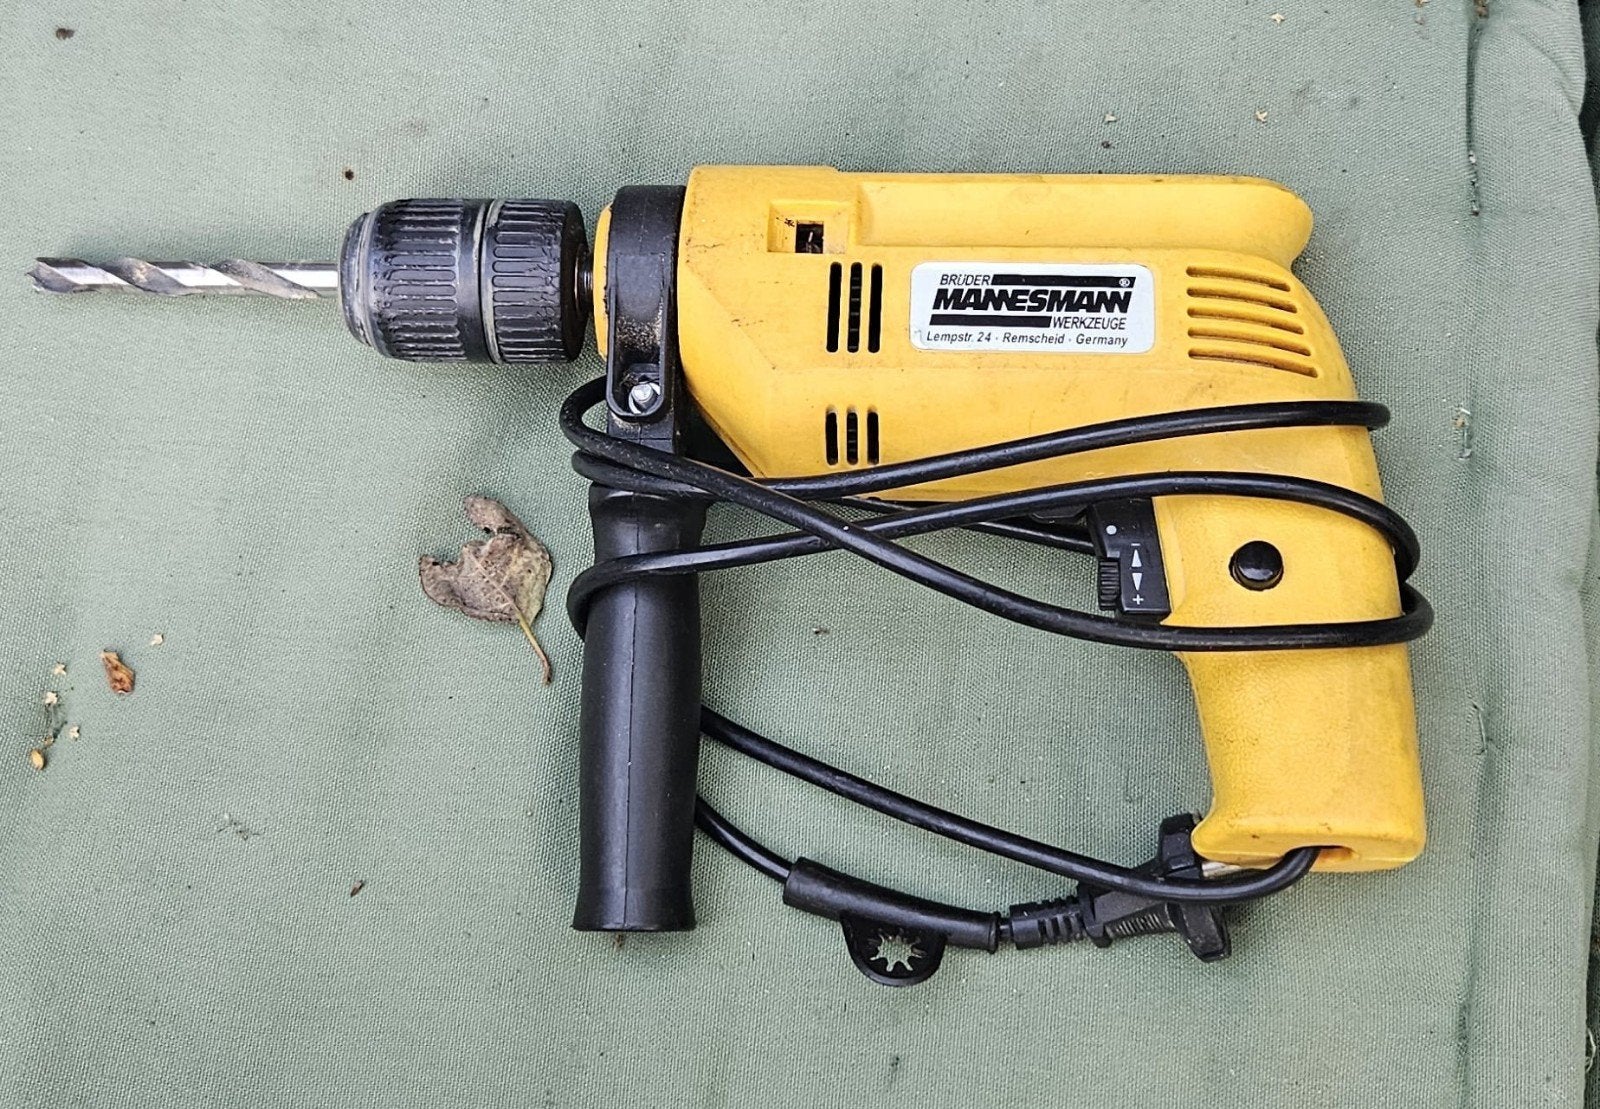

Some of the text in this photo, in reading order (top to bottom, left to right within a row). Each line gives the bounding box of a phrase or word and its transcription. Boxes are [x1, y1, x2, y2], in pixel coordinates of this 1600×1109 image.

[940, 274, 991, 285] BRÜDER
[932, 288, 1132, 313] MANNESMANN
[1052, 316, 1126, 330] WERKZEUGE
[977, 332, 991, 342] 24
[1003, 332, 1065, 344] Remscheid
[1076, 335, 1128, 347] Germany
